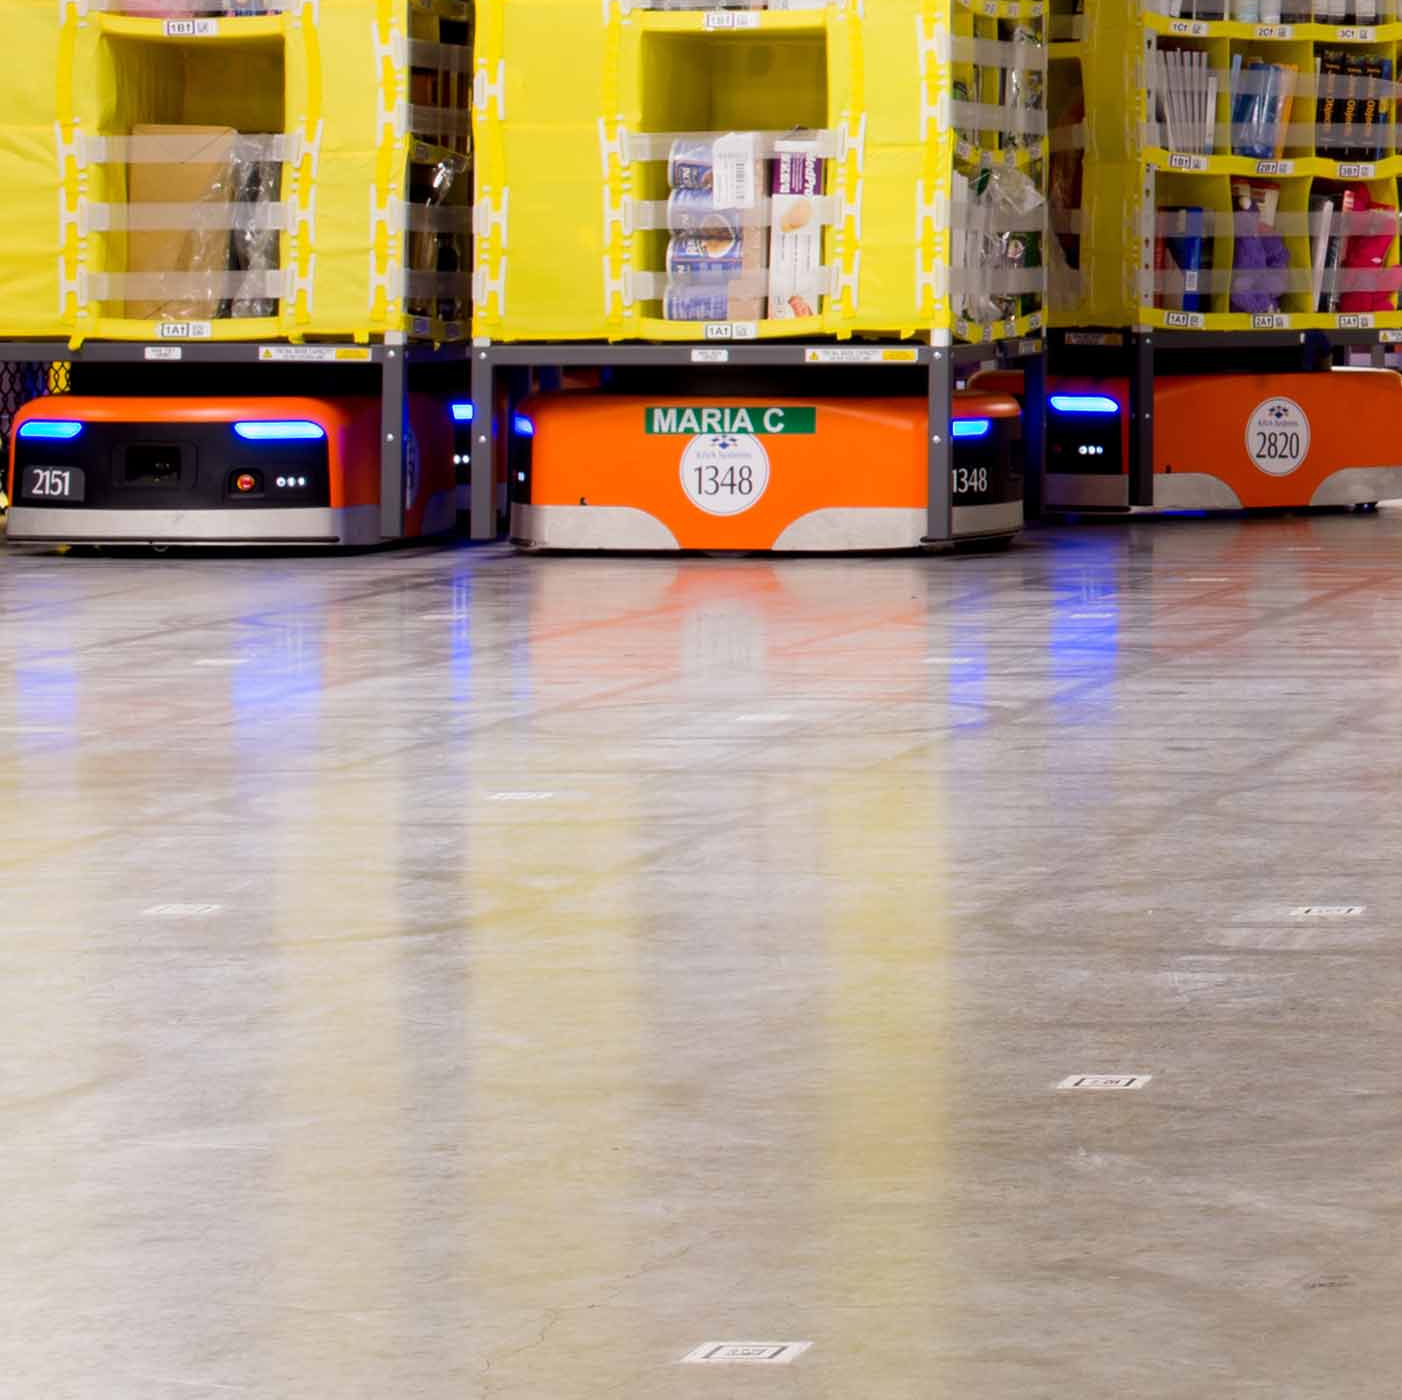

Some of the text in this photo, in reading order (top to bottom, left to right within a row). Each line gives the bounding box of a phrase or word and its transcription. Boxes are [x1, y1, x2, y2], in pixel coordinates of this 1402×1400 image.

[652, 408, 785, 433] MARIA C
[1255, 432, 1300, 459] 2820
[31, 469, 70, 496] 2151
[693, 465, 754, 496] 1348
[951, 467, 988, 493] 1348
